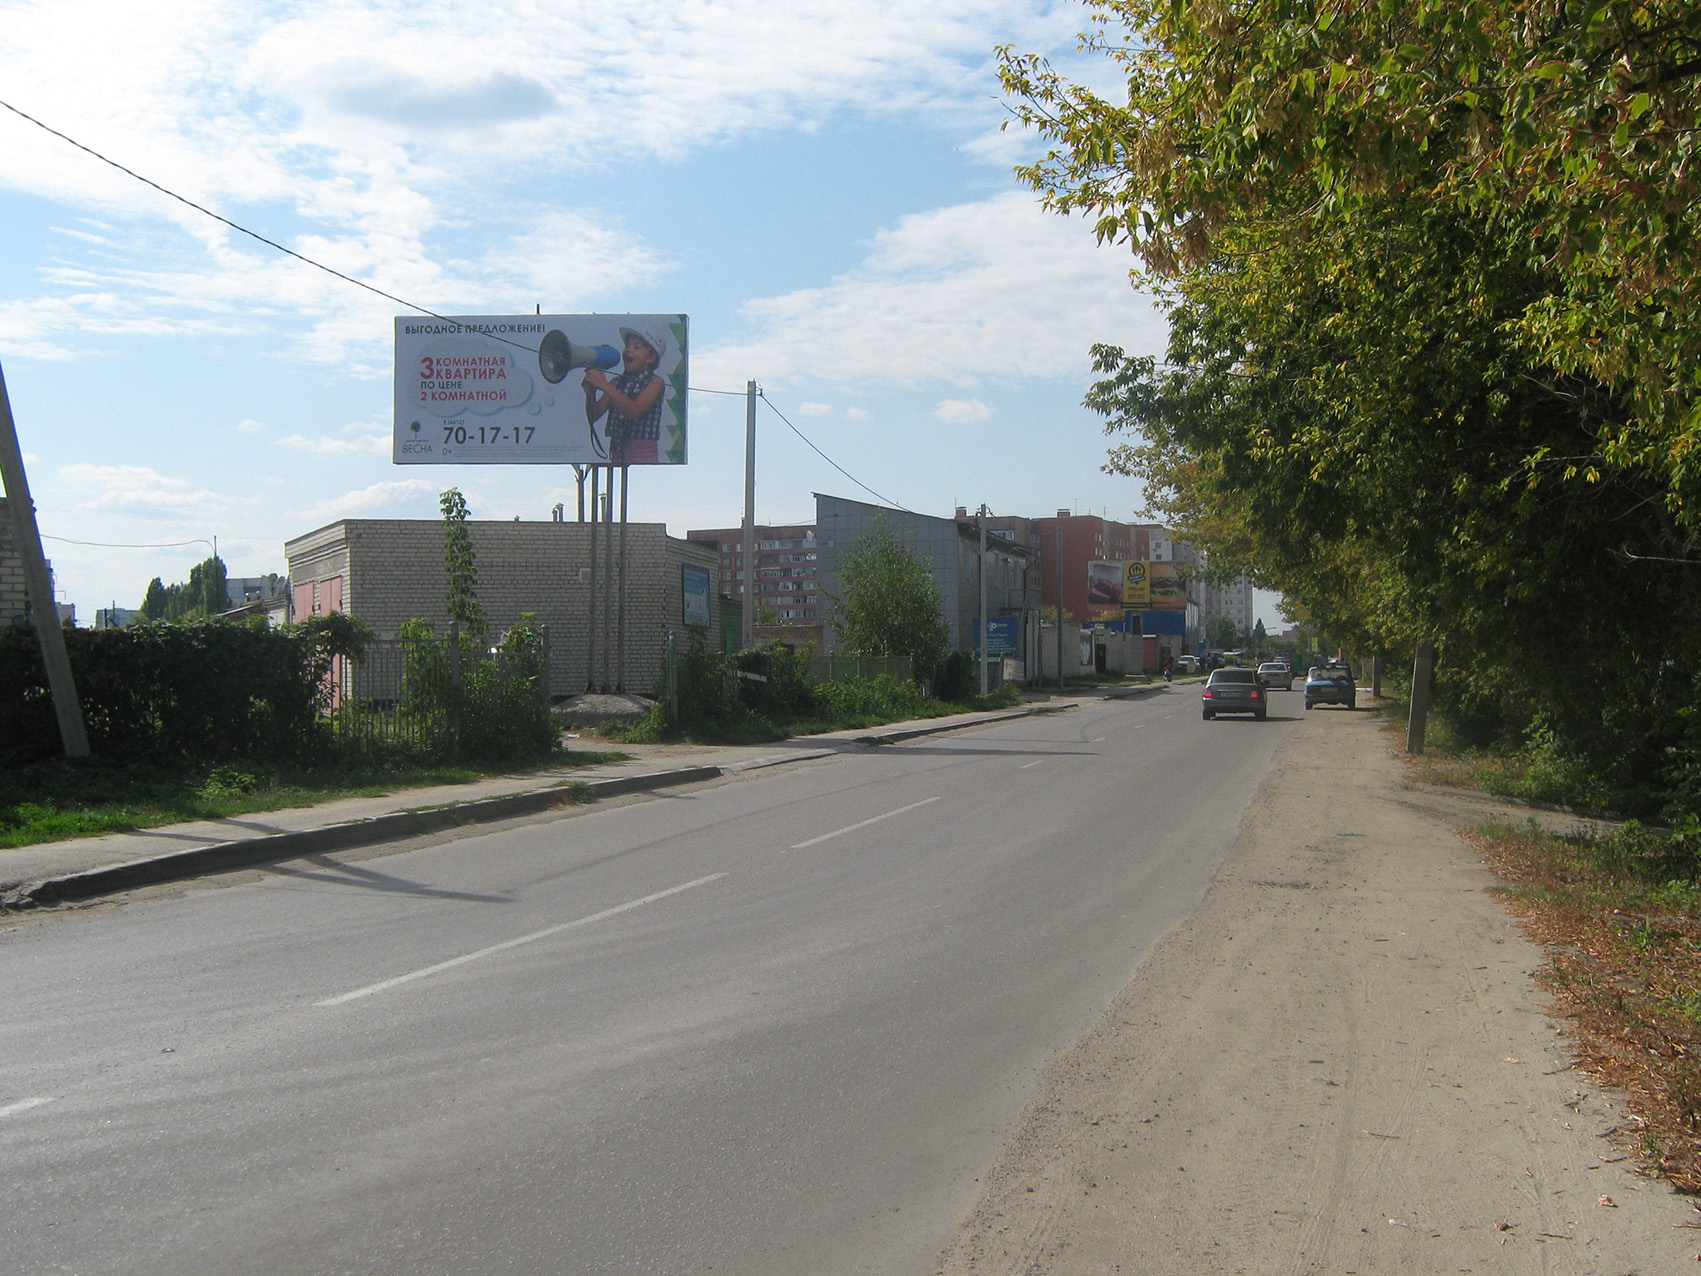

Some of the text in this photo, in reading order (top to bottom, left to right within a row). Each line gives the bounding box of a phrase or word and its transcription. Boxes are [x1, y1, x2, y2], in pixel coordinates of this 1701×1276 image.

[405, 324, 545, 334] ВЫГОДНОЕ ПРЕДЛОЖЕНИЕ!
[420, 356, 506, 379] 3 КОМНАТНАЯ
[436, 368, 507, 379] КВАРТИРА
[421, 381, 463, 390] ПО ЦЕНЕ
[421, 391, 427, 401] 2
[443, 427, 536, 444] 70-17-17
[402, 444, 433, 454] ВЕСНА
